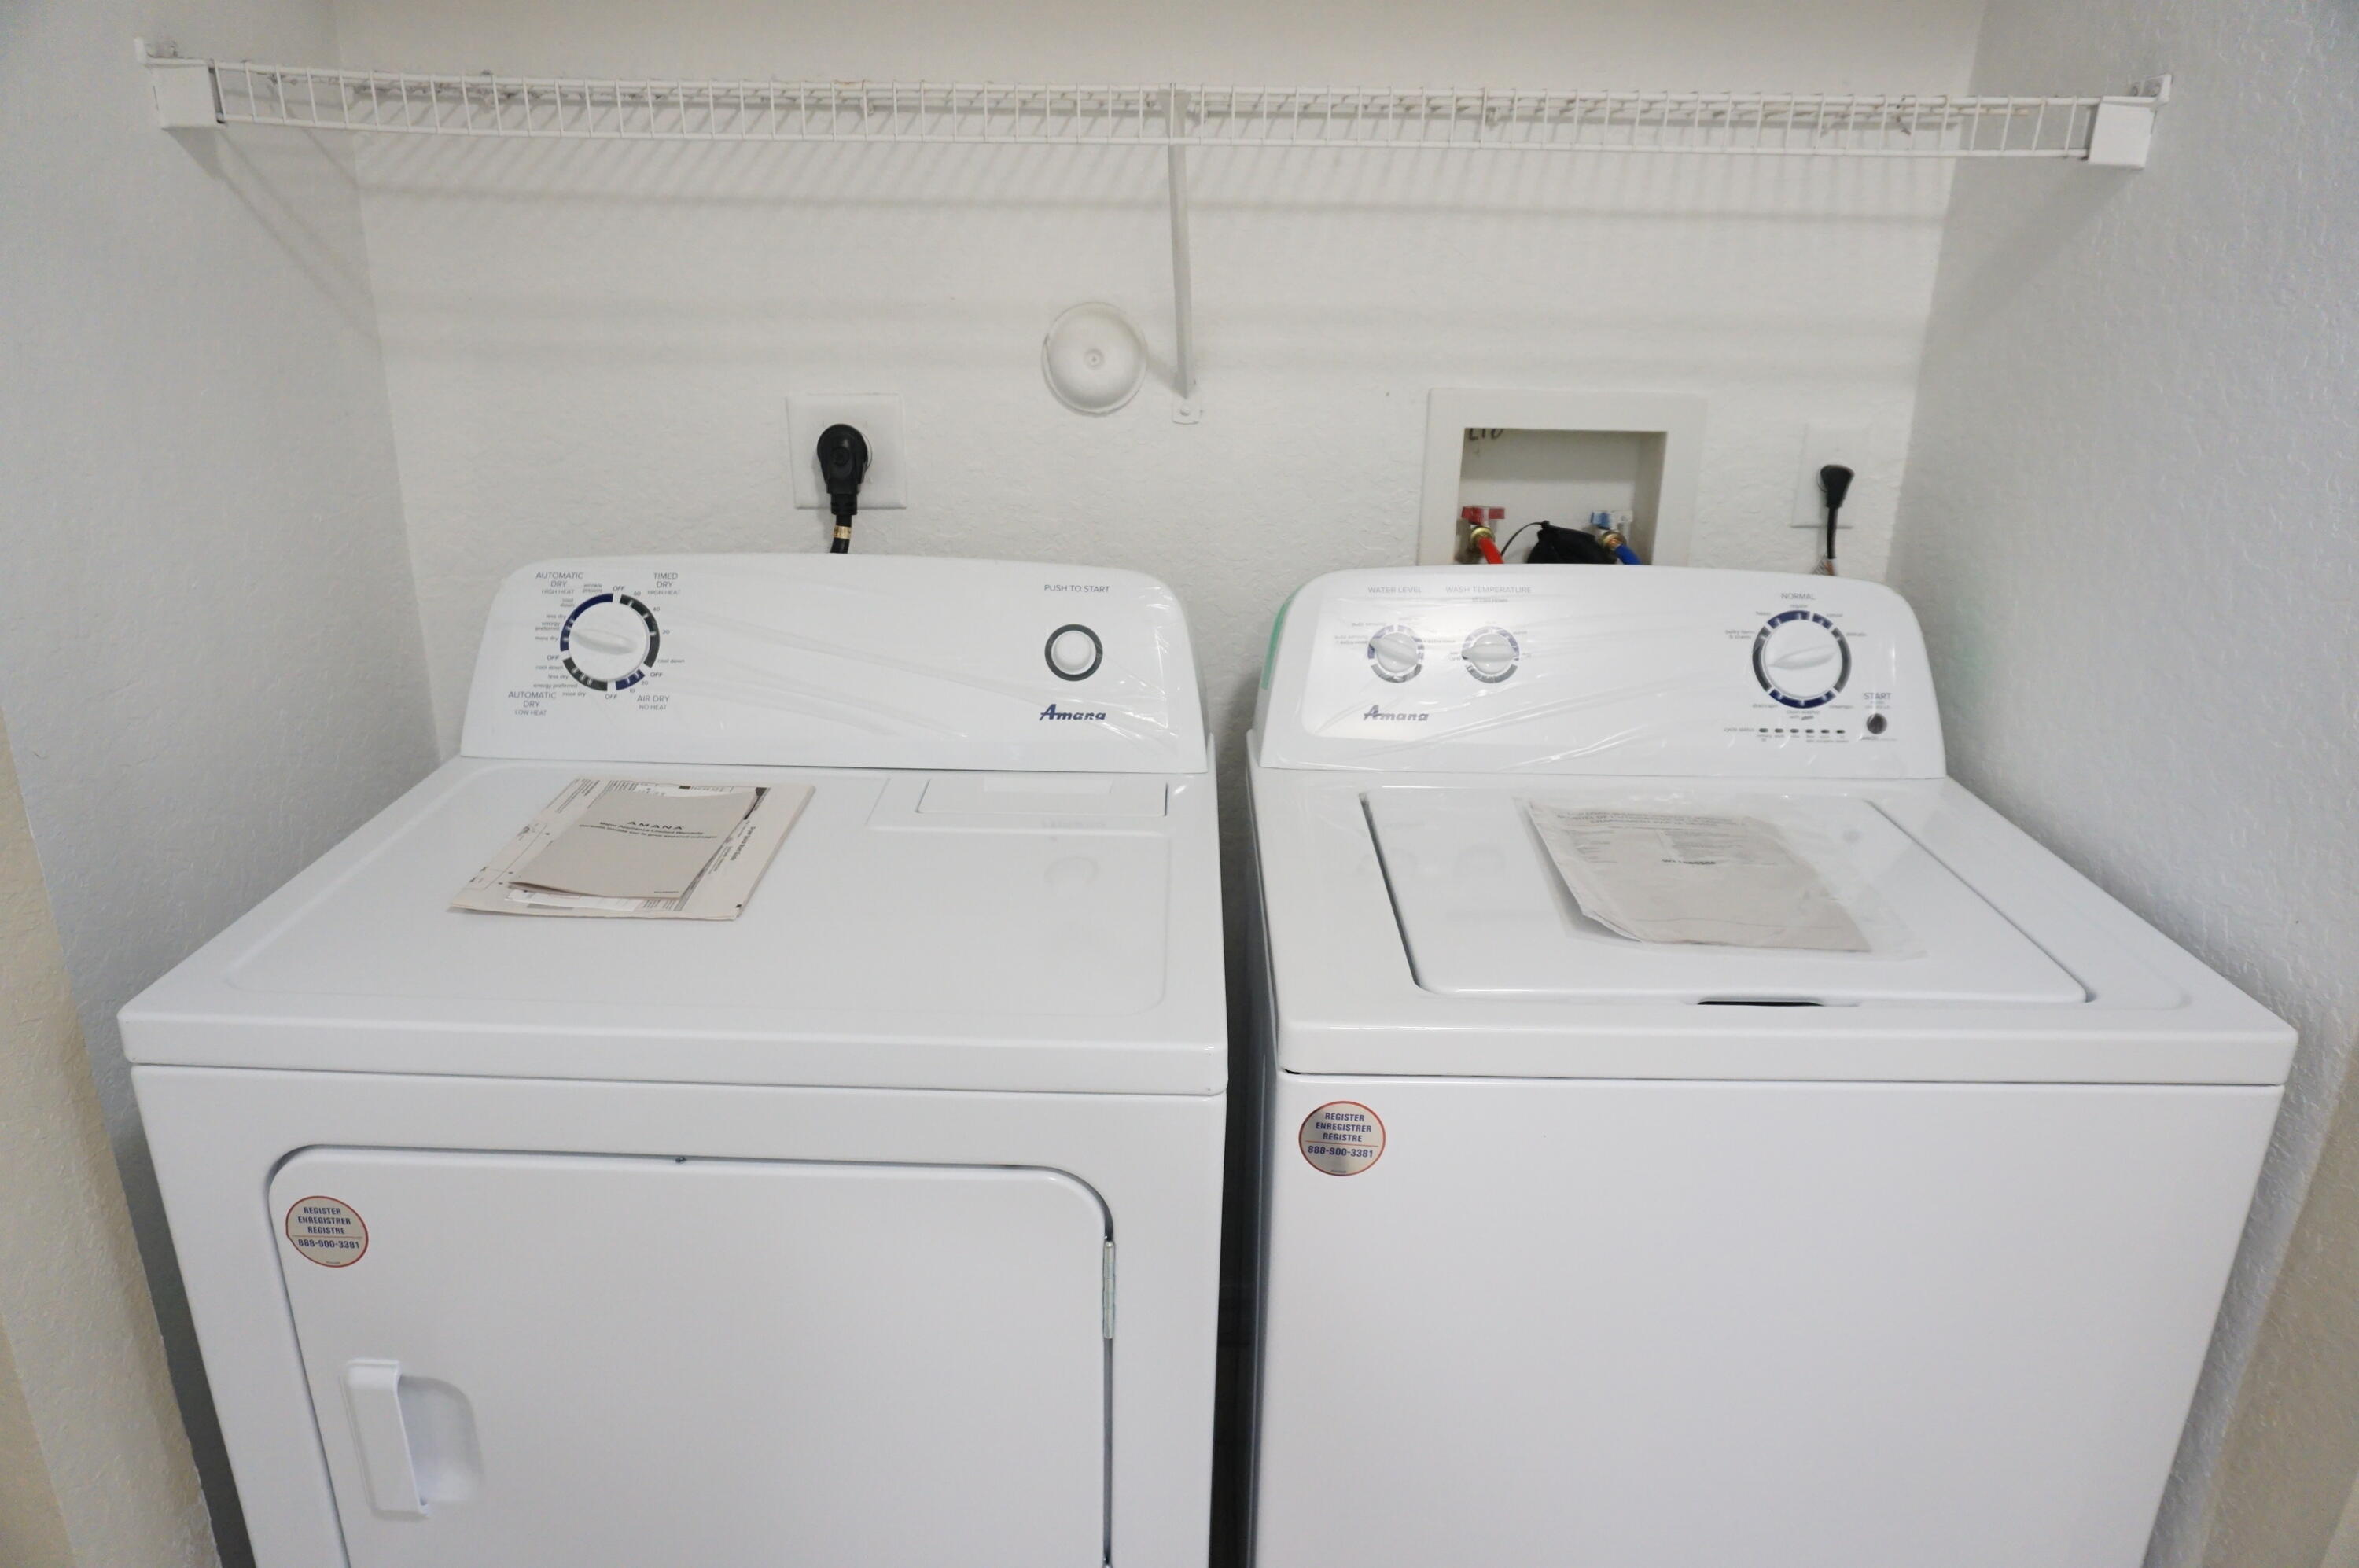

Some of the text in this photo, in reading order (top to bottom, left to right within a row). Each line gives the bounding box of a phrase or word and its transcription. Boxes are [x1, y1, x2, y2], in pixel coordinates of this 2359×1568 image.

[1039, 704, 1107, 721] Amana
[1363, 704, 1430, 722] Amana
[627, 821, 683, 830] AMANA
[1324, 1112, 1365, 1122] REGISTER
[1315, 1121, 1372, 1133] ENREGISTRER
[1323, 1132, 1363, 1143] REGISTRE
[1308, 1145, 1374, 1158] 888-900-3381
[304, 1206, 341, 1215] REGISTER
[298, 1216, 351, 1225] ENREGISTRER
[307, 1225, 346, 1235] REGISTRE
[298, 1239, 360, 1250] 888-900-3381
